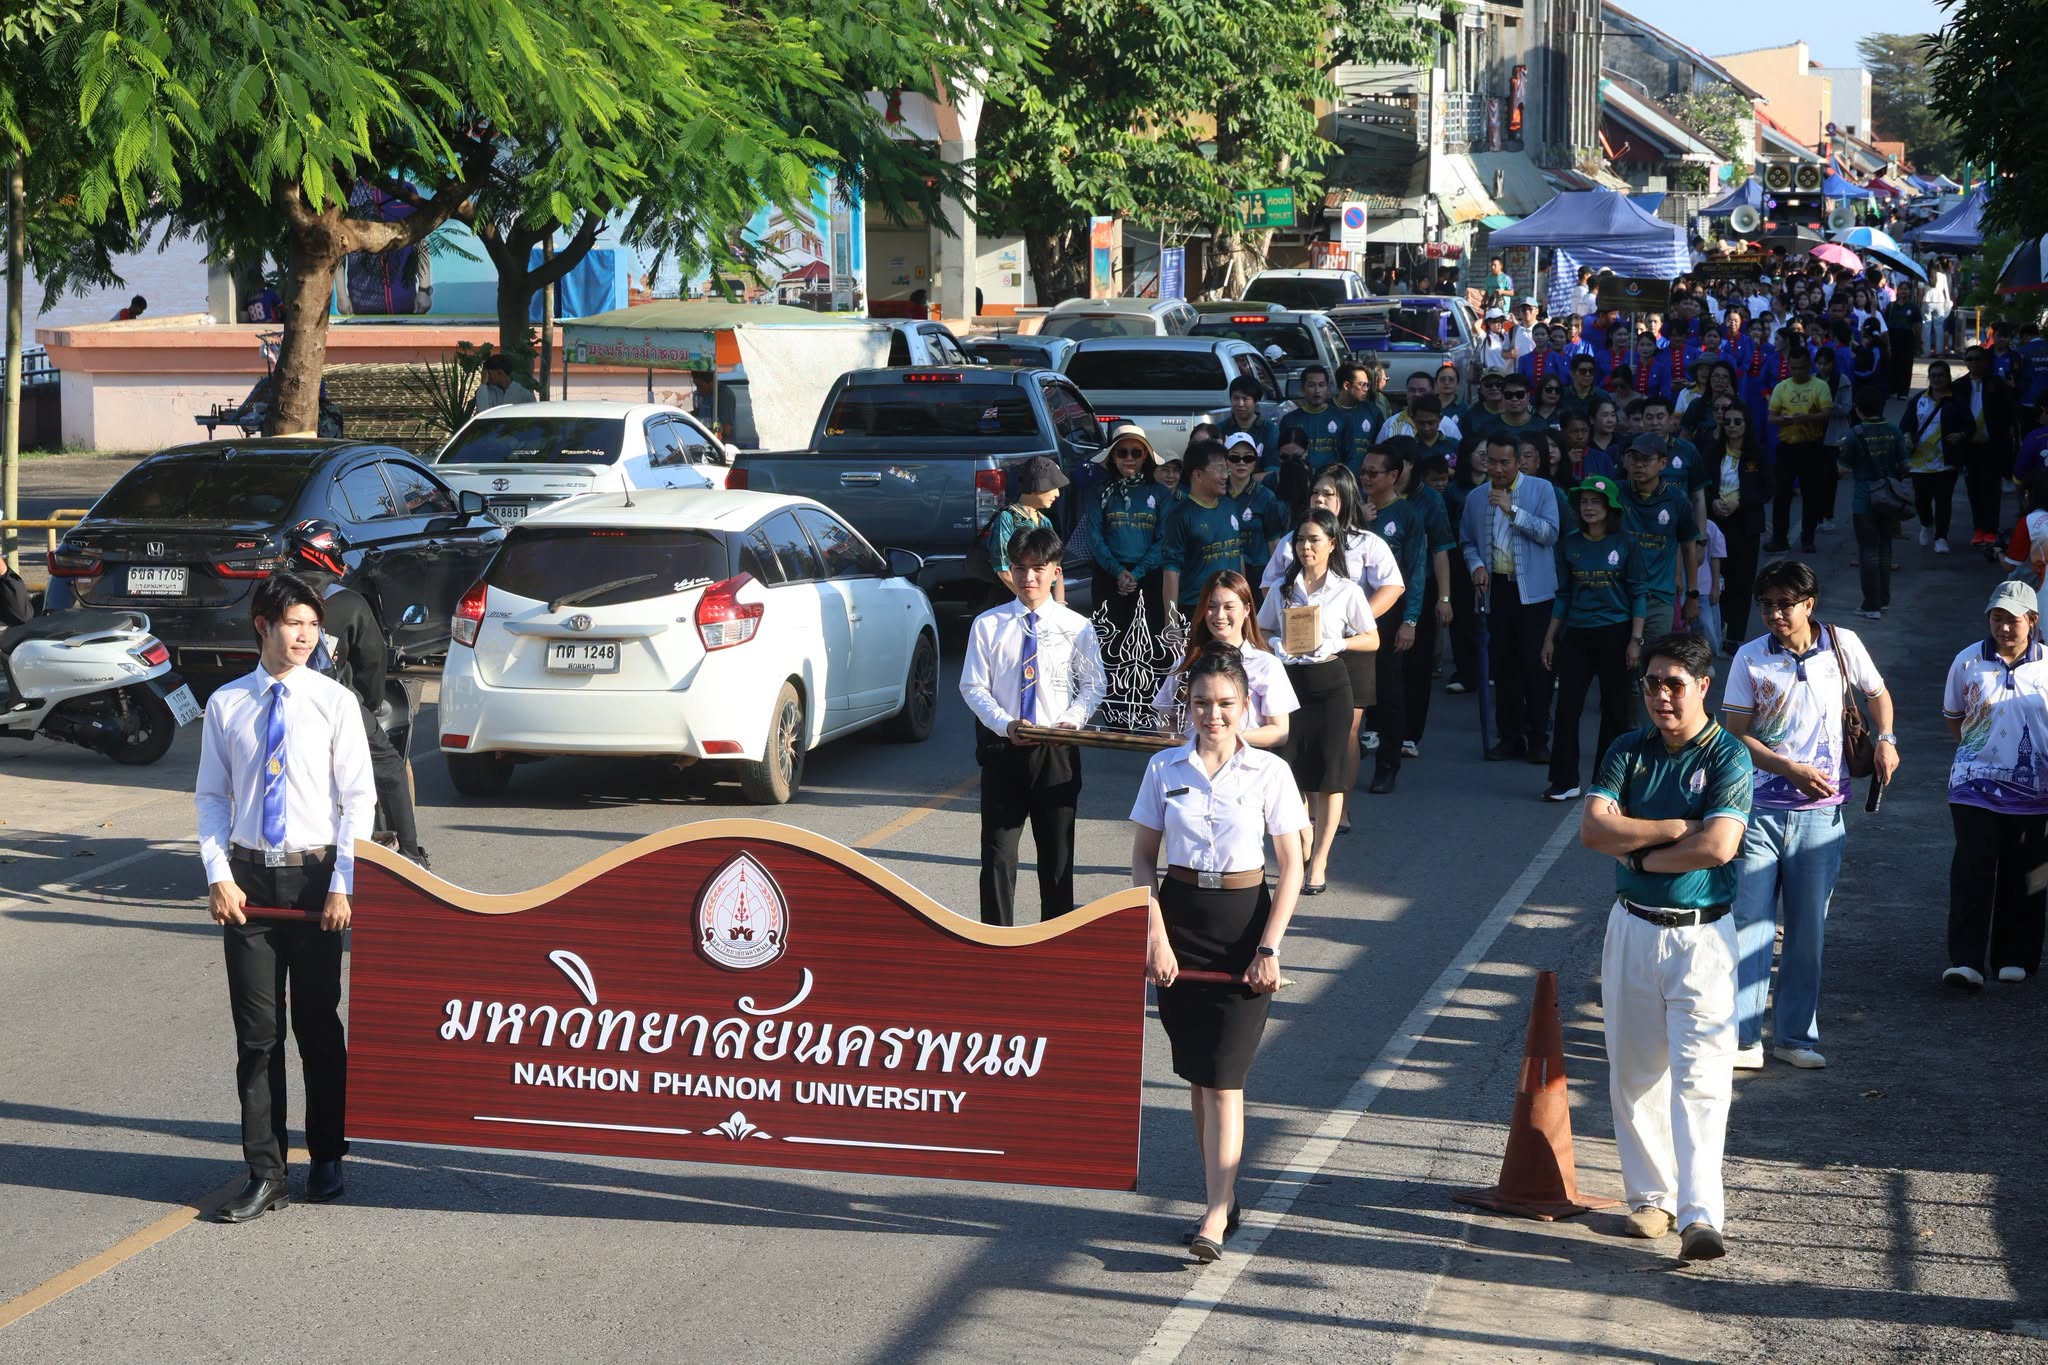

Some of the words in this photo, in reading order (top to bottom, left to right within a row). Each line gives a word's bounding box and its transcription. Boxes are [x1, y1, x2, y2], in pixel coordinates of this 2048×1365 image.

[248, 302, 266, 321] 88
[587, 336, 690, 362] มะพร้าวน้ำหอม
[501, 507, 524, 518] 8891
[158, 568, 185, 581] 1705
[584, 645, 615, 659] 1248
[180, 706, 198, 722] 3130
[440, 950, 1047, 1078] มหาวิทยาลัยนครพนม
[513, 1061, 640, 1093] NAKHON
[652, 1070, 781, 1102] PHANOM
[795, 1080, 967, 1114] UNIVERSITY
